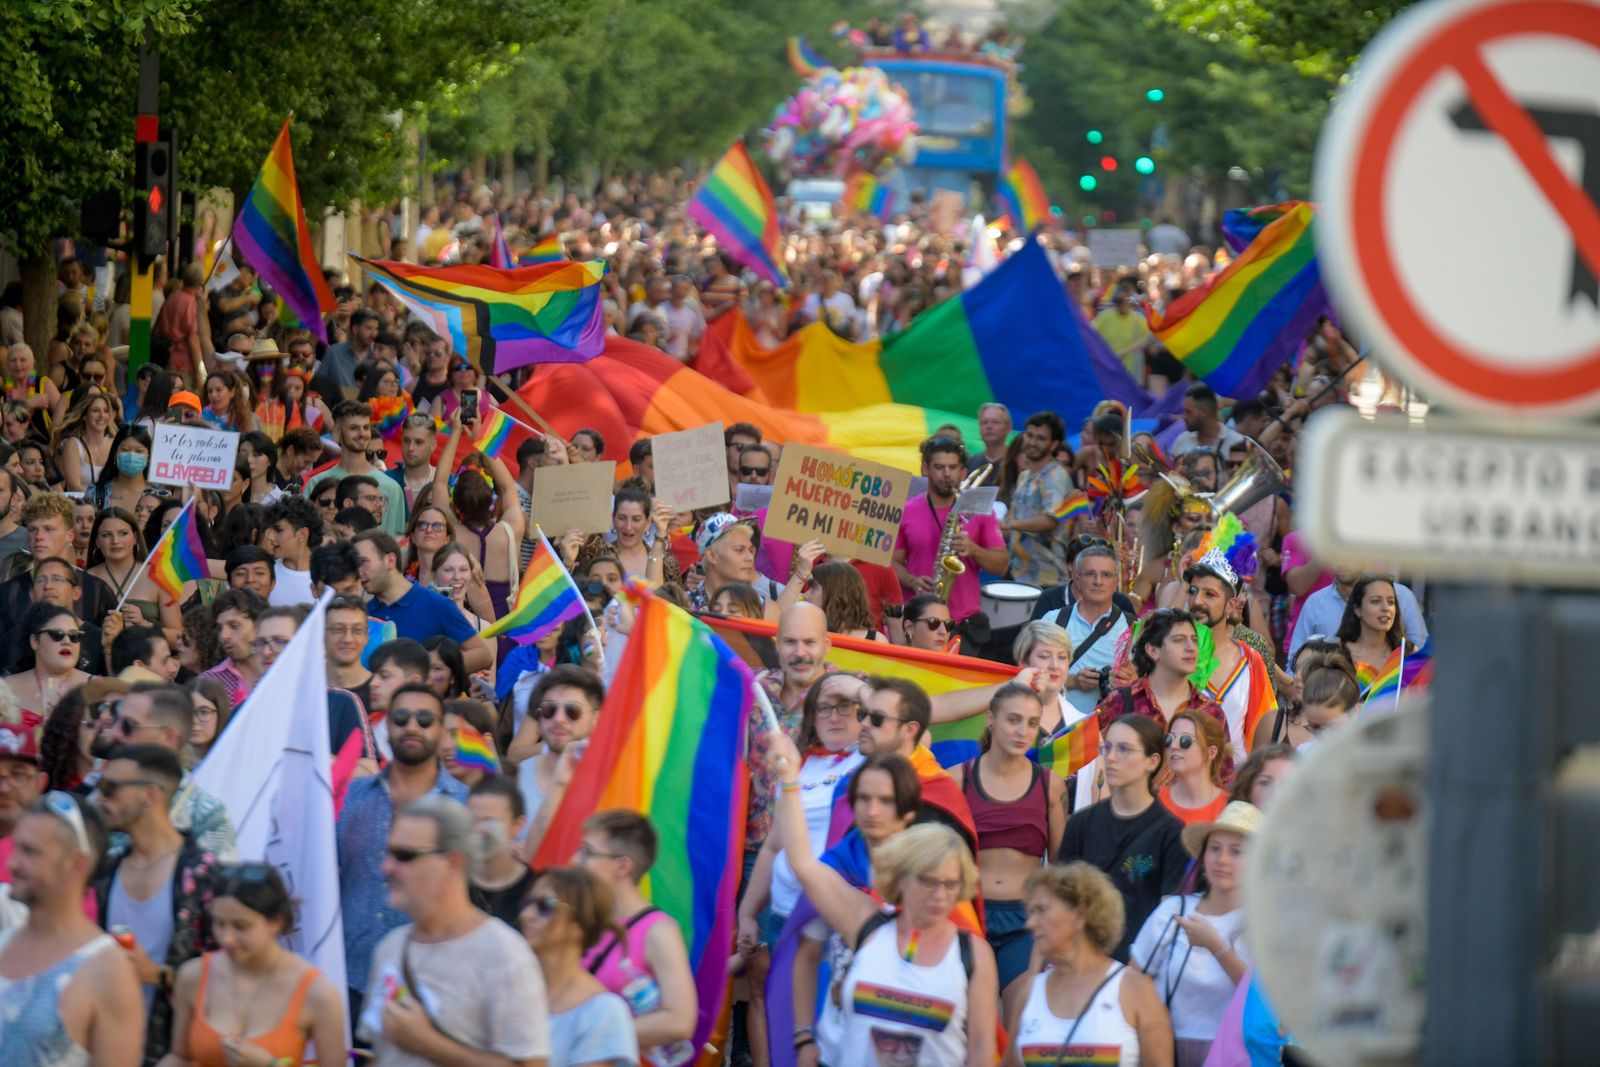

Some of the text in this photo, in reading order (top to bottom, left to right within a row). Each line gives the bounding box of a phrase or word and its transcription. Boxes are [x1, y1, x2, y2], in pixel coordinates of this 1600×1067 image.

[195, 436, 228, 449] molesta
[800, 455, 893, 498] HOMÓFOBO
[1358, 440, 1567, 498] EXCEPTO
[786, 503, 893, 552] PA MI HUERTO
